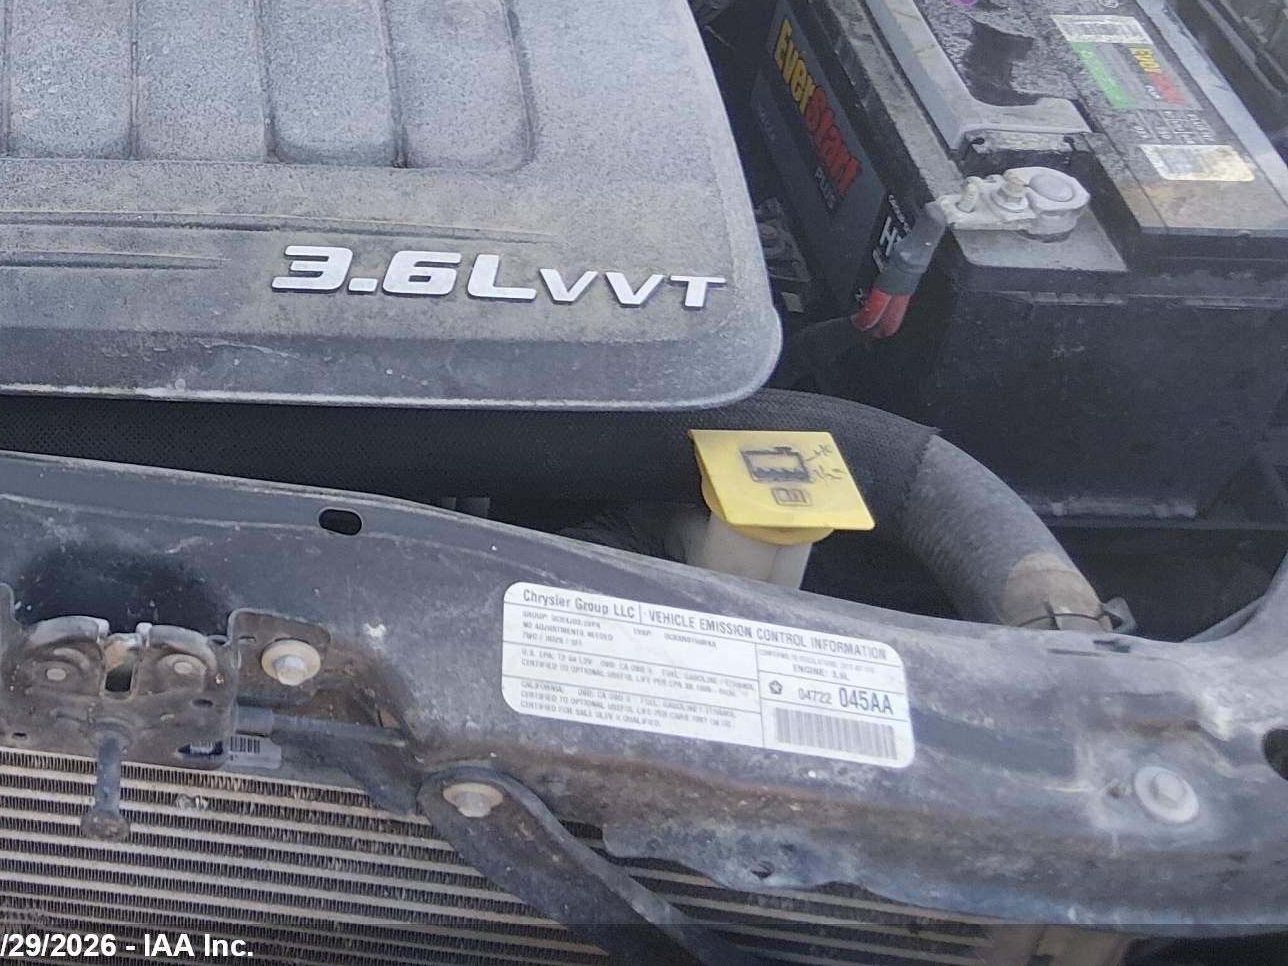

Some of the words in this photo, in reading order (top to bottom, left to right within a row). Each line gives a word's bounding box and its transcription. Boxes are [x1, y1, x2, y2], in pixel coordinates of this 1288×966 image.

[522, 589, 572, 609] Chrysler
[574, 597, 609, 618] Group
[613, 603, 635, 619] LLC
[648, 610, 696, 631] VEHICLE
[700, 617, 753, 639] EMISSION
[756, 628, 807, 648] CONTROL
[811, 638, 888, 661] INFORMATION
[798, 687, 832, 705] 04722
[838, 687, 894, 715] 045AA
